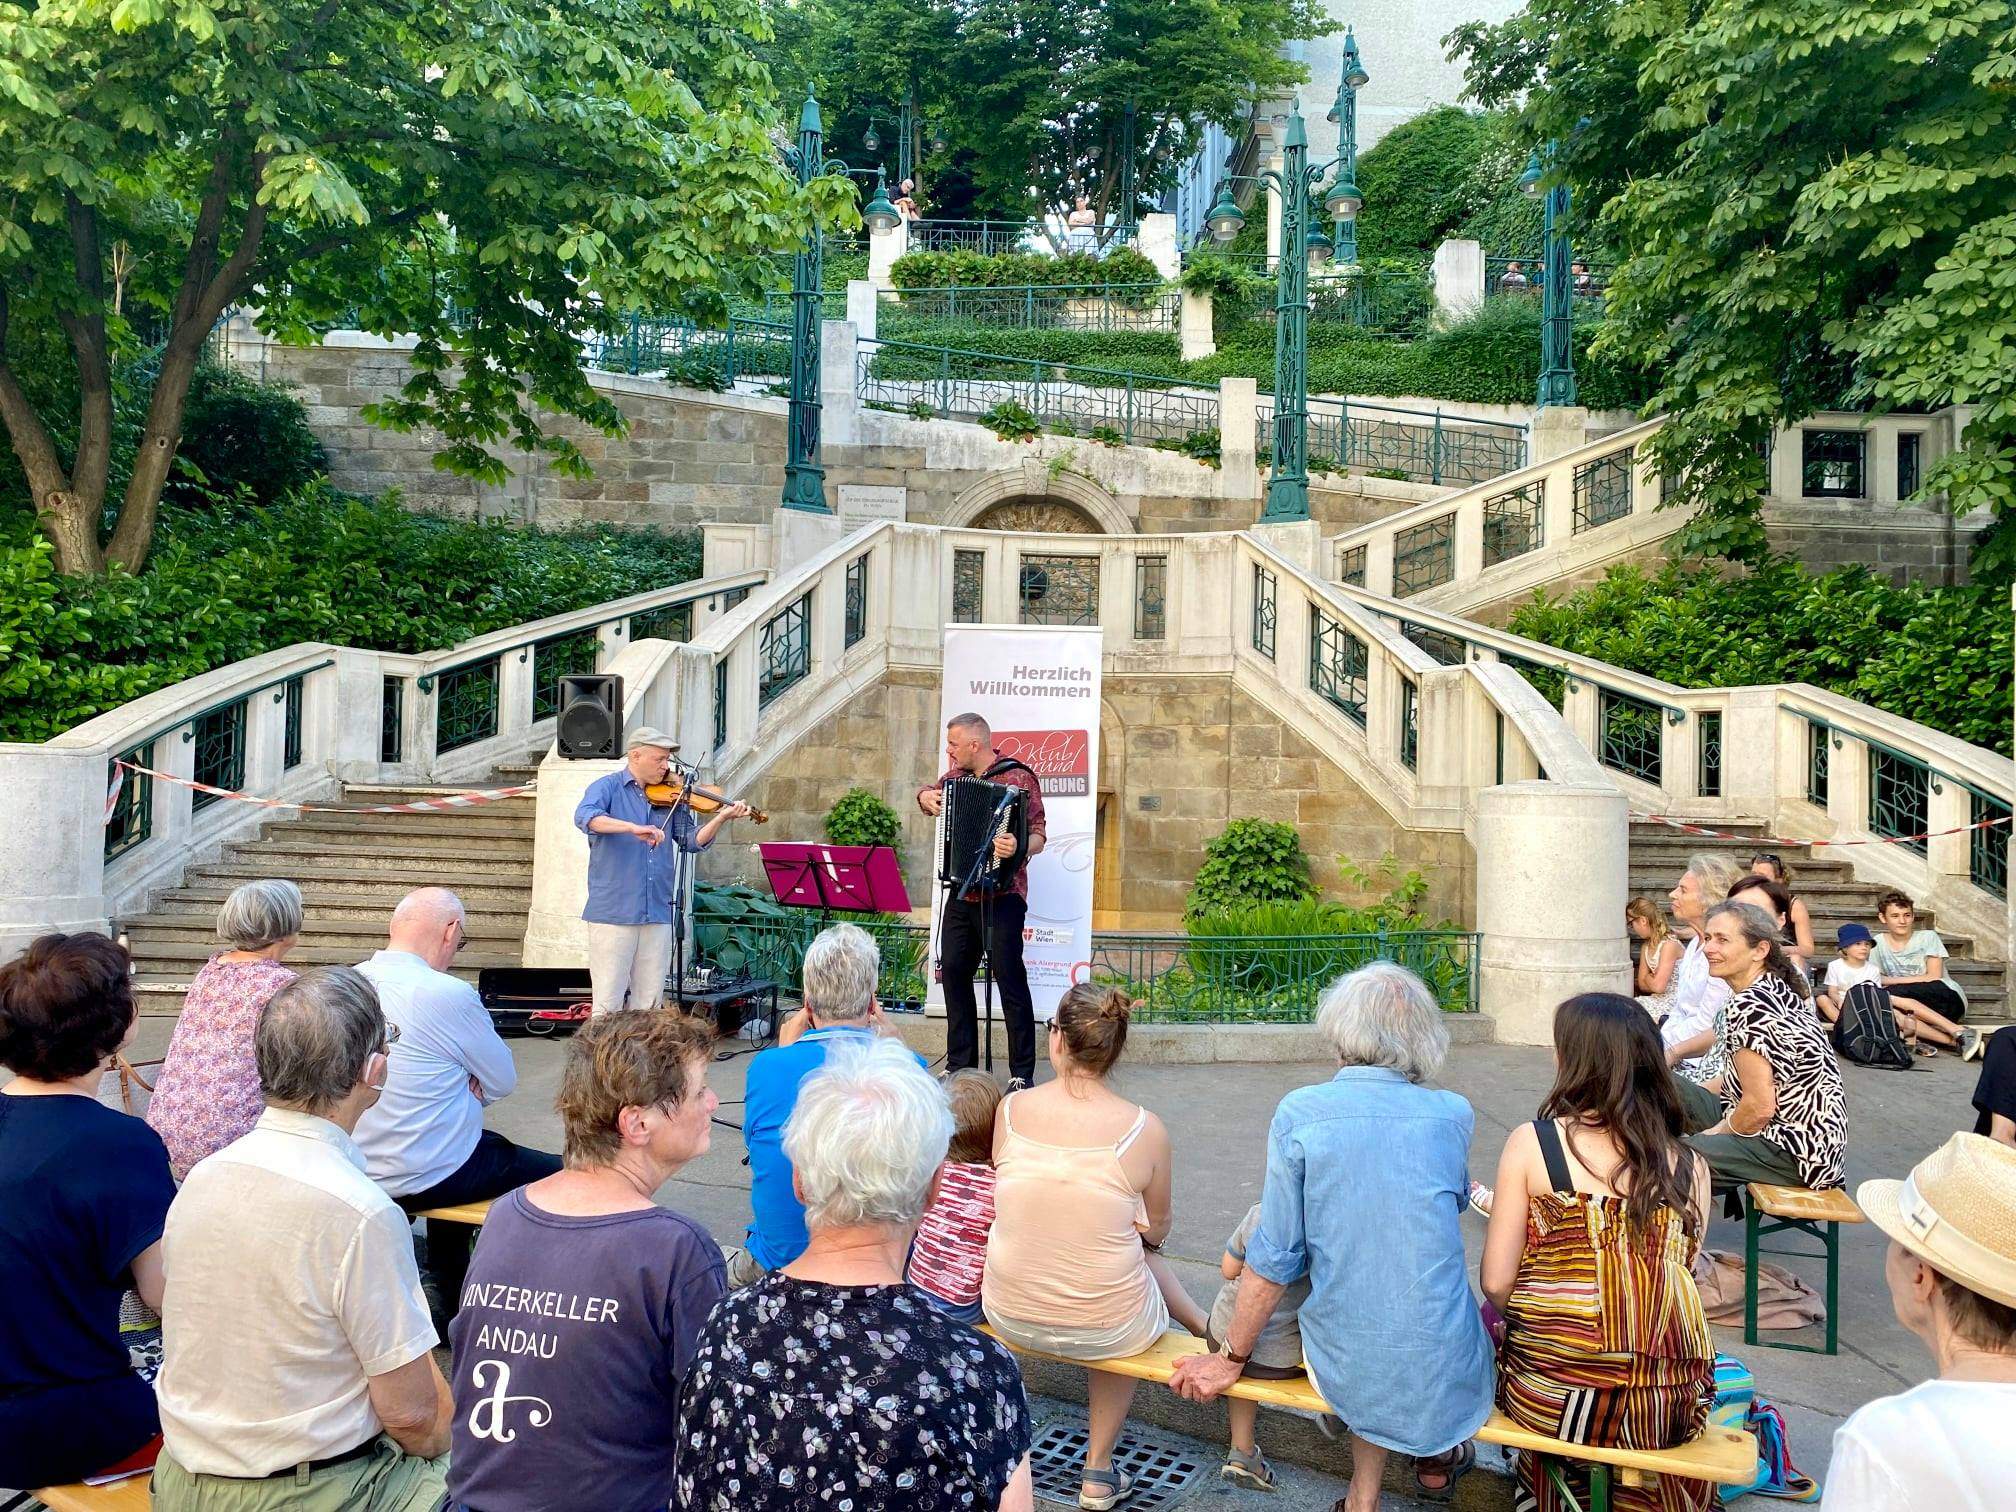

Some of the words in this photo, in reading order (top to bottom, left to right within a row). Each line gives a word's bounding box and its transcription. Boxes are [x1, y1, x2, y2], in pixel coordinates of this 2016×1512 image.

[1012, 665, 1092, 681] Herzlich
[970, 680, 1091, 698] Willkommen
[1019, 731, 1075, 762] Klub
[1038, 777, 1086, 793] NIGUNG
[1035, 928, 1054, 937] Stadt
[1035, 935, 1054, 943] Wien
[476, 1324, 558, 1359] ANDAU
